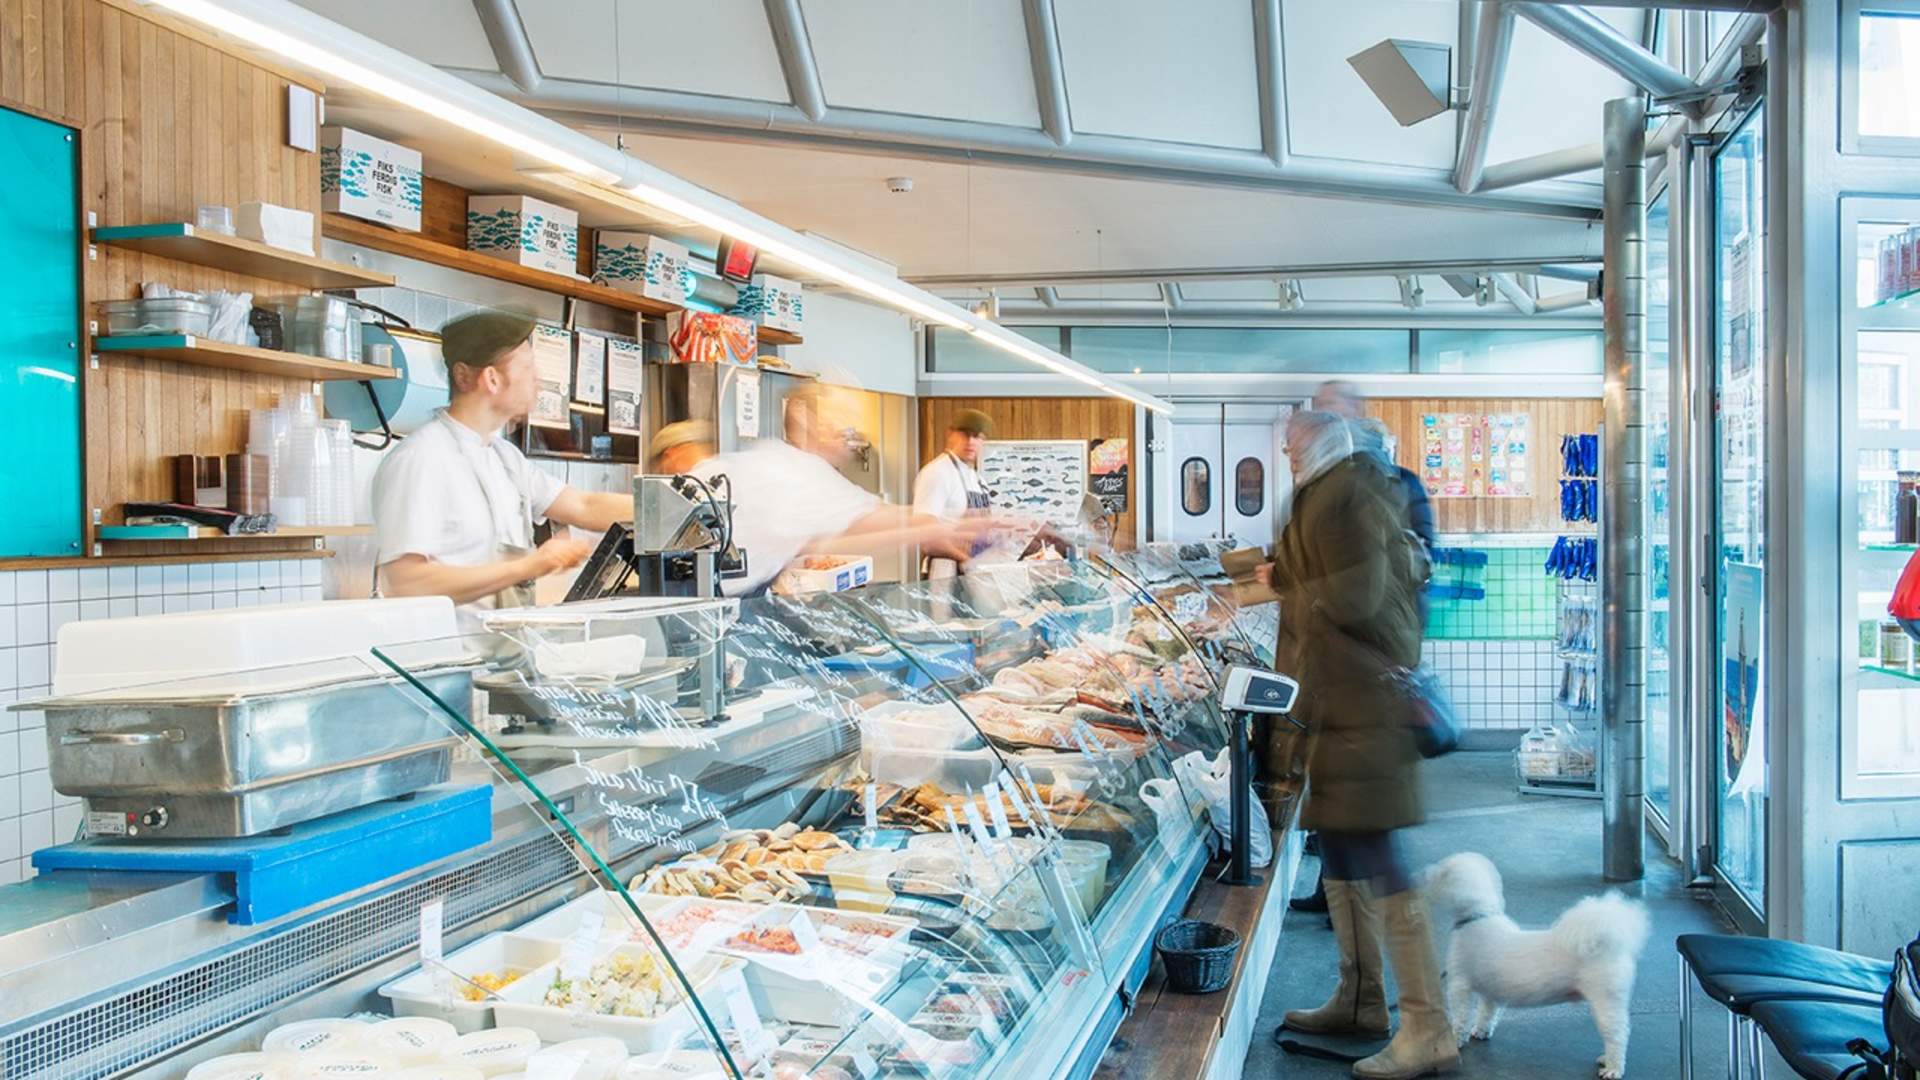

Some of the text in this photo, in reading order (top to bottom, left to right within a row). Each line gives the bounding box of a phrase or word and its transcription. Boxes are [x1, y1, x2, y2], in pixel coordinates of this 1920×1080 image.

[377, 160, 394, 173] FIKS
[372, 170, 397, 186] FERDIG
[376, 183, 393, 195] FISK
